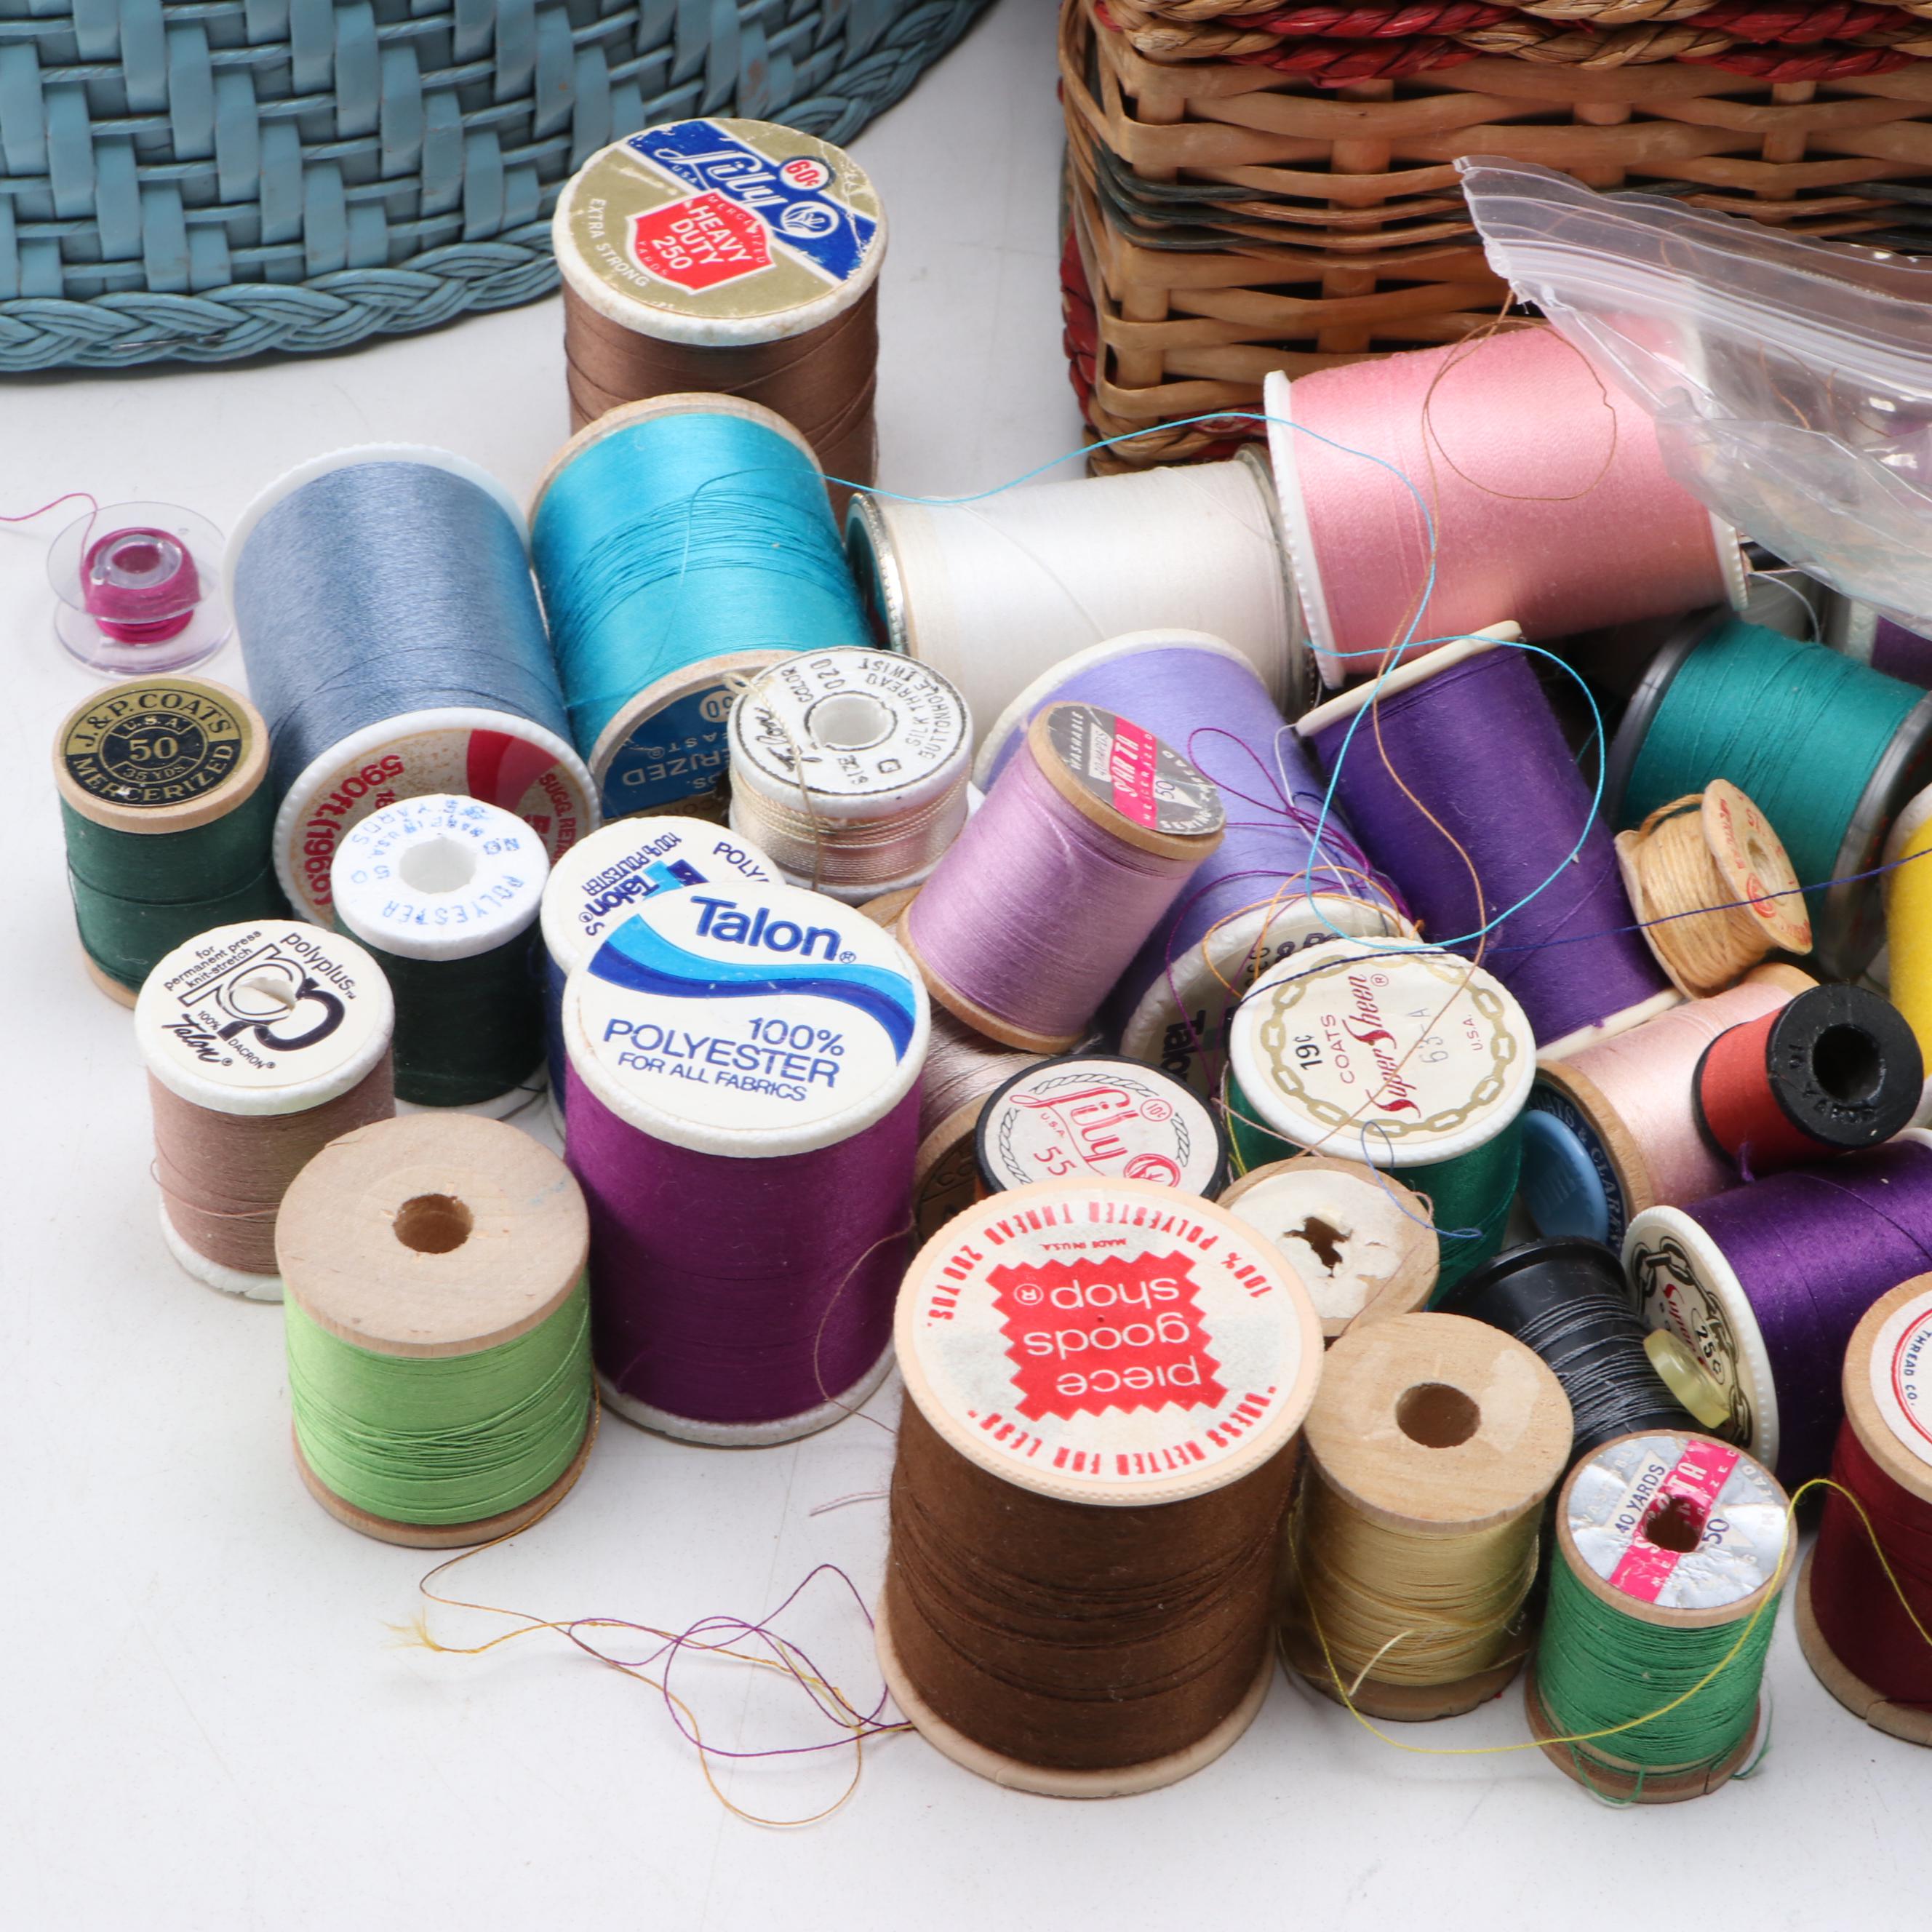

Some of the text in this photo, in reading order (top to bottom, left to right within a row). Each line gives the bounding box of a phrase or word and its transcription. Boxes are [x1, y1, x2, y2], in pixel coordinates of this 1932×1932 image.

[655, 148, 789, 207] Lily
[589, 198, 650, 287] EXTRA STRONG
[652, 236, 693, 271] 250
[670, 217, 726, 266] DUTY
[687, 204, 754, 263] HEAVY
[637, 241, 668, 277] YARDS
[781, 666, 814, 703] COLOR
[810, 658, 845, 690] 020
[139, 693, 231, 734] COATS
[858, 658, 951, 760] BUTTONHOLE TWIST
[866, 673, 929, 747] SILK THREAD
[129, 737, 179, 762] 50
[838, 754, 869, 786] SIZE
[73, 745, 233, 802] MERCERIZED
[123, 768, 147, 781] 35
[1155, 780, 1175, 799] 50
[582, 851, 652, 895] POLYESTER
[383, 874, 524, 925] POLYESTER
[585, 875, 659, 917] Talon
[690, 895, 842, 961] Talon
[164, 930, 262, 991] permanent press
[185, 947, 253, 989] knit-stretch
[196, 945, 215, 959] for
[280, 933, 356, 993] polyplus
[161, 1013, 221, 1063] Talon
[197, 1010, 266, 1069] 100% DACRON
[603, 1018, 840, 1087] POLYESTER
[749, 1018, 845, 1057] 100%
[1160, 1010, 1206, 1077] Talo
[1293, 1034, 1323, 1071] 19¢
[1320, 1014, 1355, 1084] COATS
[1341, 975, 1421, 1119] Super Sheen
[618, 1052, 807, 1102] FOR ALL FABRICS
[1010, 1086, 1139, 1169] Lily
[1034, 1146, 1077, 1175] 55
[984, 1204, 1072, 1245] THREAD
[1089, 1201, 1218, 1250] POLYESTER
[1093, 1238, 1127, 1249] MADE
[943, 1245, 983, 1280] 200
[1221, 1252, 1273, 1298] 100%
[1050, 1277, 1179, 1309] shop
[1024, 1312, 1191, 1360] goods
[1056, 1354, 1201, 1395] piece
[1053, 1447, 1101, 1474] FOR
[1117, 1440, 1206, 1475] BETTER
[1626, 1463, 1666, 1512] YARDS
[1701, 1517, 1730, 1545] 50
